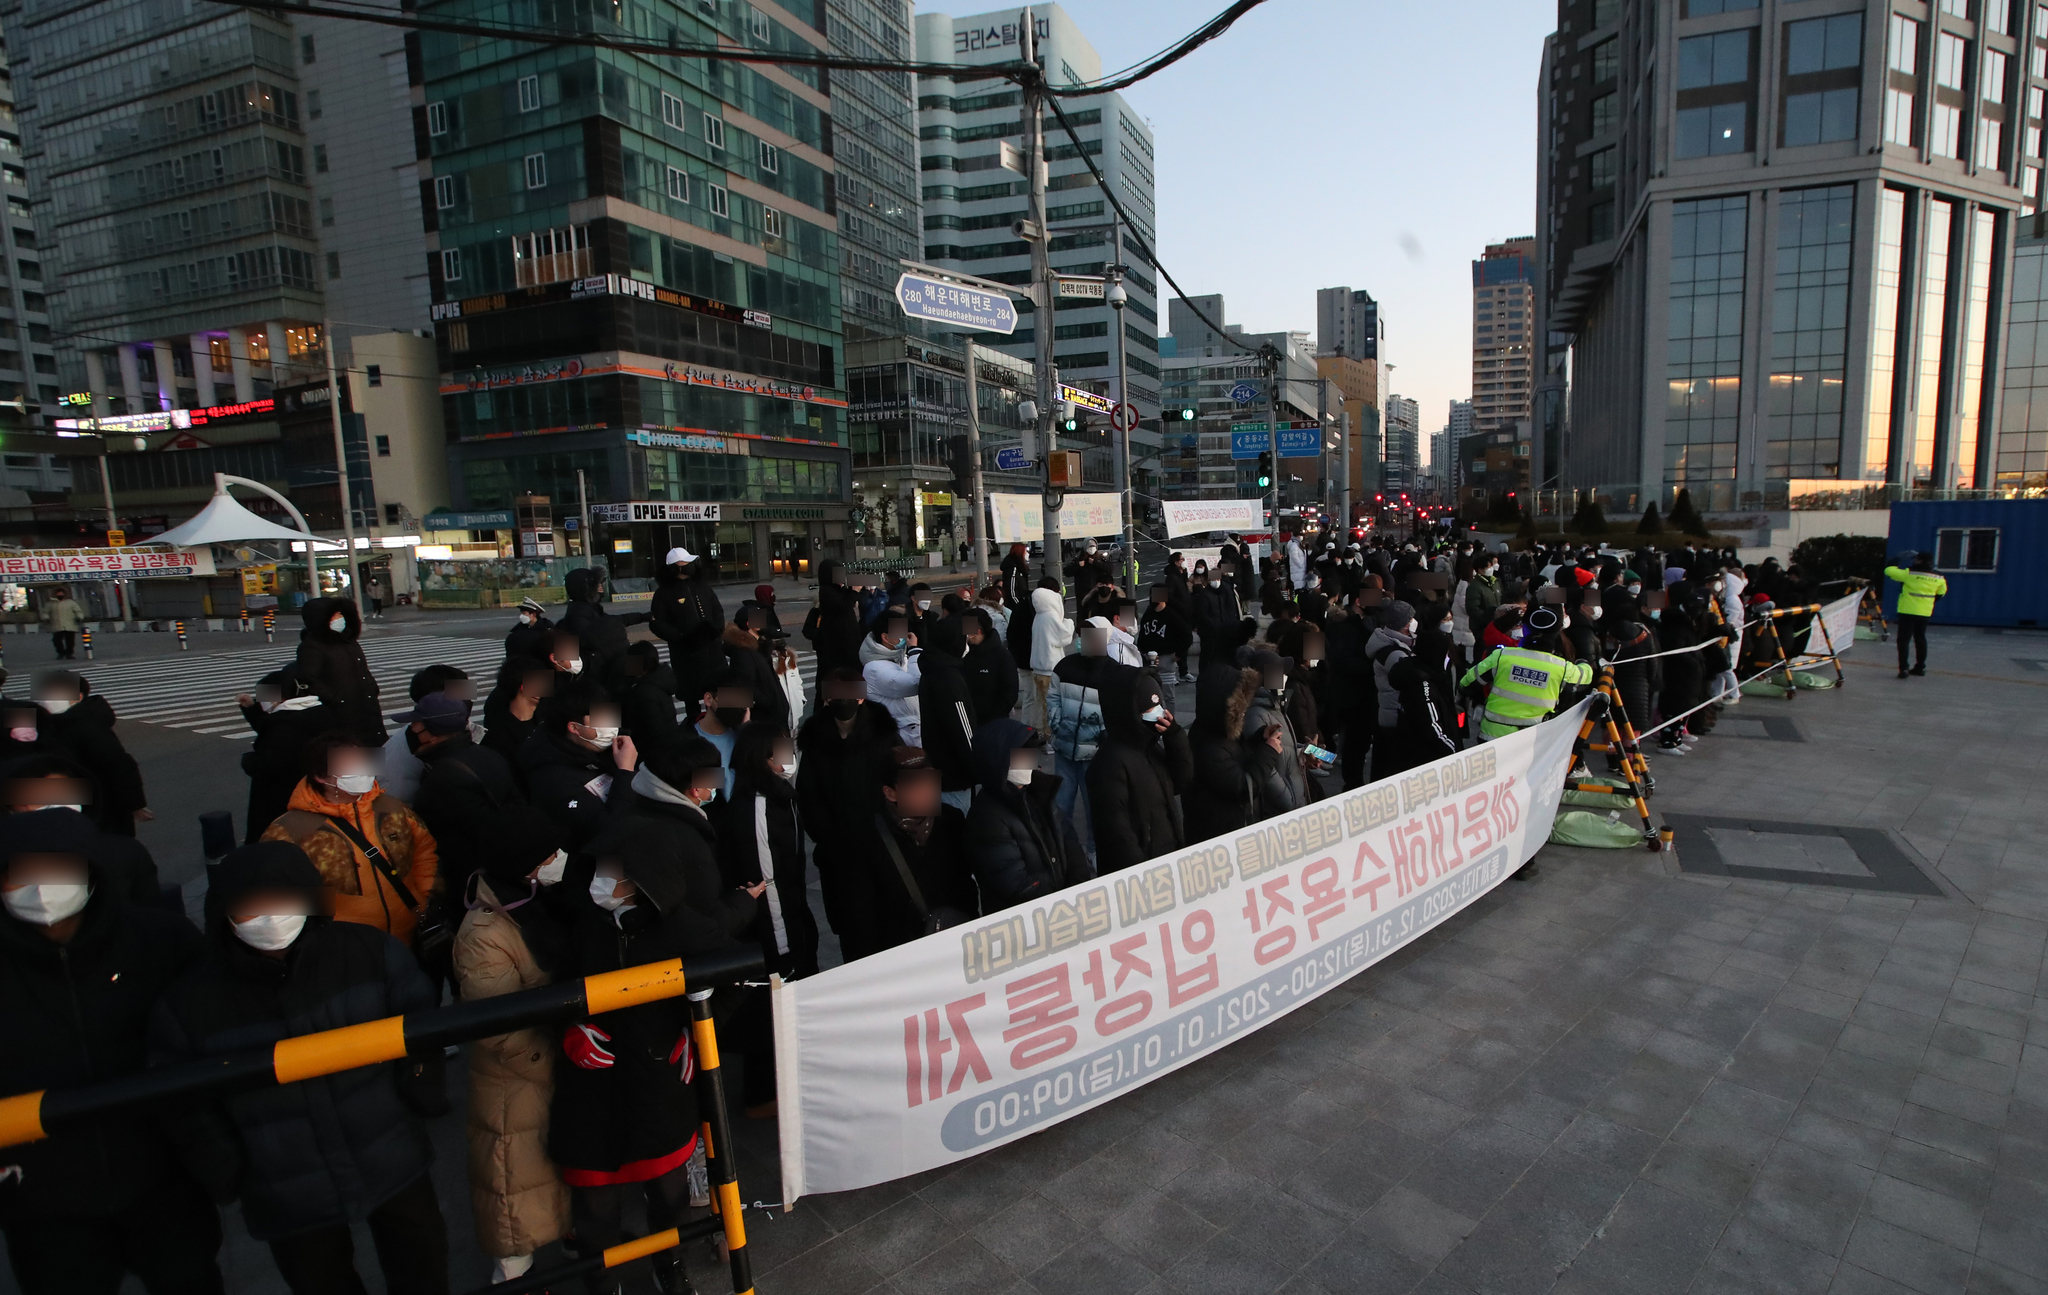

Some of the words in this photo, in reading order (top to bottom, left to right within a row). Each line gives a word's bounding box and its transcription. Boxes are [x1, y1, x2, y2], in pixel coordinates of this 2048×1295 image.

[955, 18, 1050, 53] 크리스탈치
[621, 276, 655, 301] OPUS
[905, 288, 922, 303] 280
[1061, 282, 1076, 294] 다목적
[1076, 283, 1088, 295] CCTV
[1089, 284, 1103, 297] 작동중
[924, 284, 993, 313] 해운대해변로
[432, 302, 461, 320] OPUS
[743, 309, 754, 320] 4F
[922, 303, 997, 327] Haeundaehaebyeon-ro
[996, 307, 1011, 321] 284
[724, 374, 760, 393] 감자탕
[1236, 390, 1251, 400] 214
[651, 432, 685, 447] HOTEL
[1282, 433, 1307, 442] 달맞이길
[634, 504, 666, 520] OPUS
[704, 505, 718, 519] 4F
[743, 508, 795, 518] STARBUCKS
[796, 508, 825, 518] COFFEE
[130, 551, 198, 570] 입장통제
[1143, 620, 1166, 639] USA
[1513, 666, 1547, 681] 교통경찰
[1513, 676, 1543, 687] POLICE
